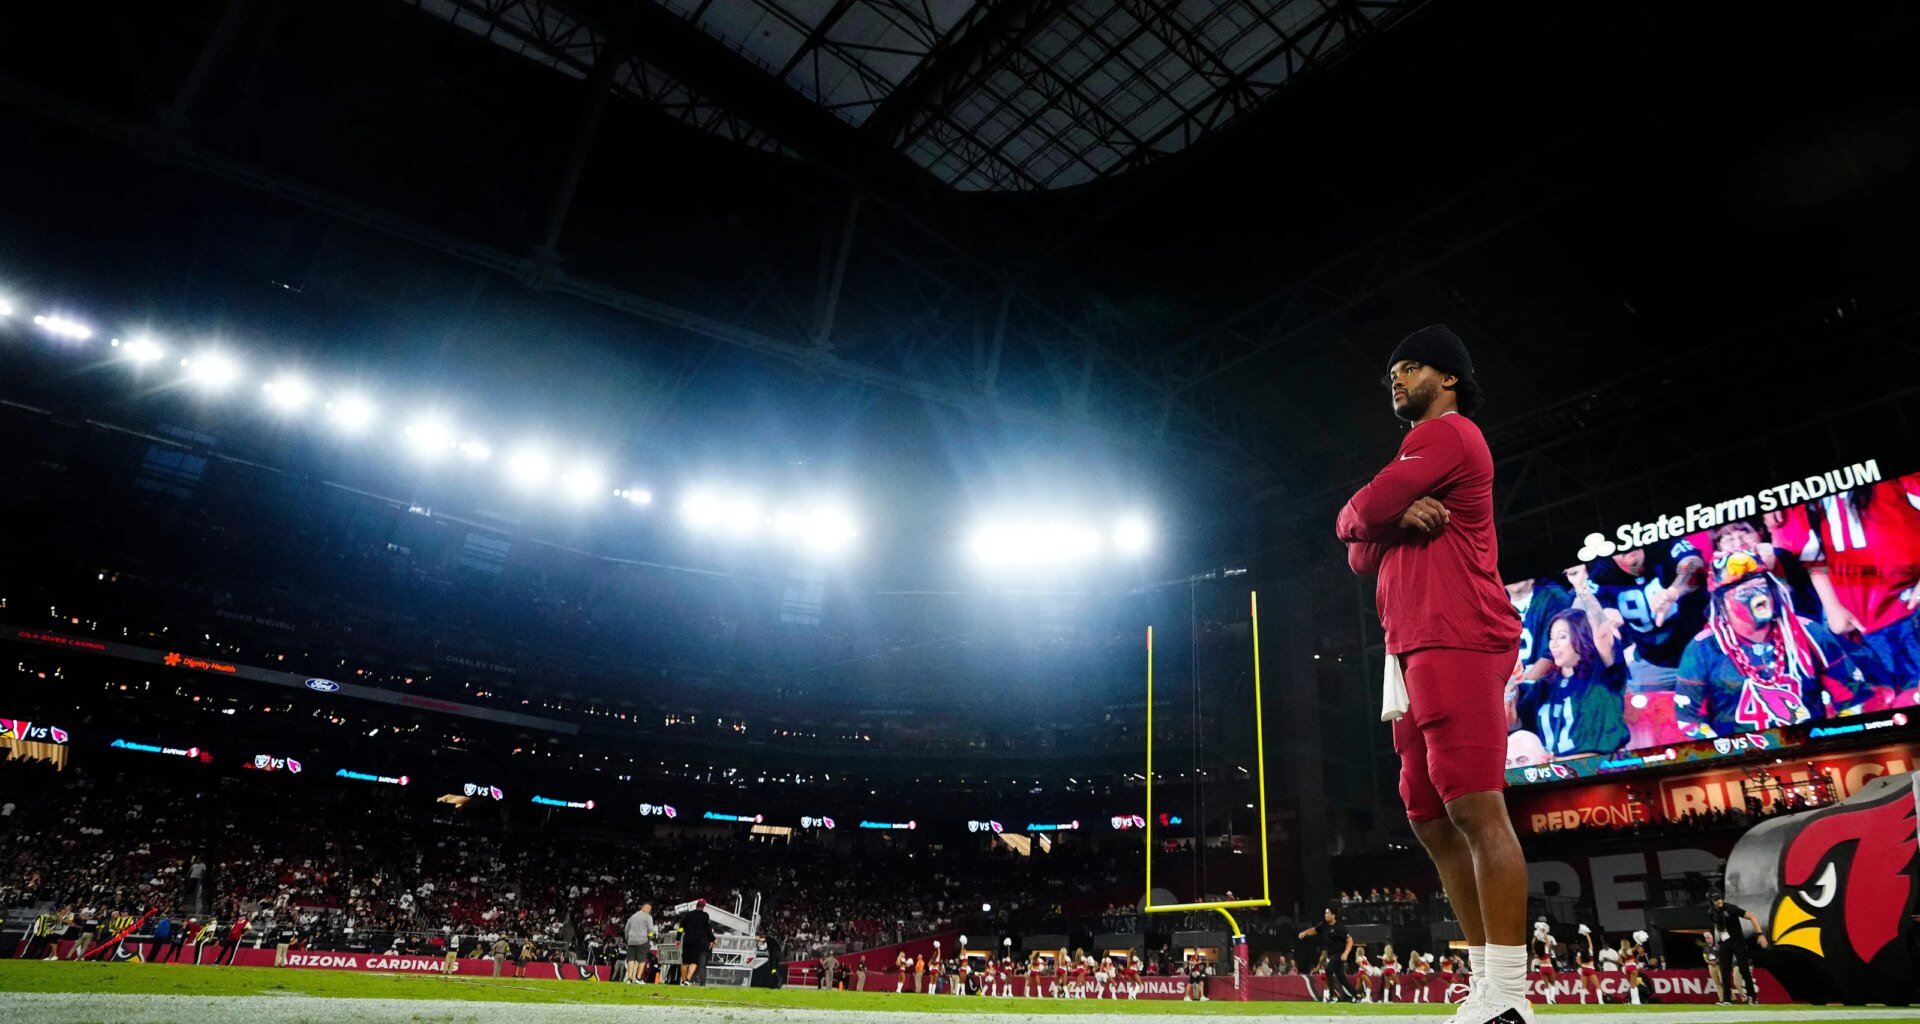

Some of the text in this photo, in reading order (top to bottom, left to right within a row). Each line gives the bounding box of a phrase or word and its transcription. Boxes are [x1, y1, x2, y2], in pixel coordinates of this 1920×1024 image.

[1758, 459, 1881, 512] STADIUM
[40, 634, 67, 644] RIVER
[211, 661, 236, 673] Health
[31, 726, 48, 739] VS
[1731, 737, 1749, 750] VS
[271, 757, 285, 769] VS
[1538, 767, 1552, 779] VS
[477, 785, 489, 797] VS
[652, 806, 663, 815] VS
[813, 818, 822, 827] VS
[979, 822, 989, 831] VS
[284, 954, 357, 968] RIZONA
